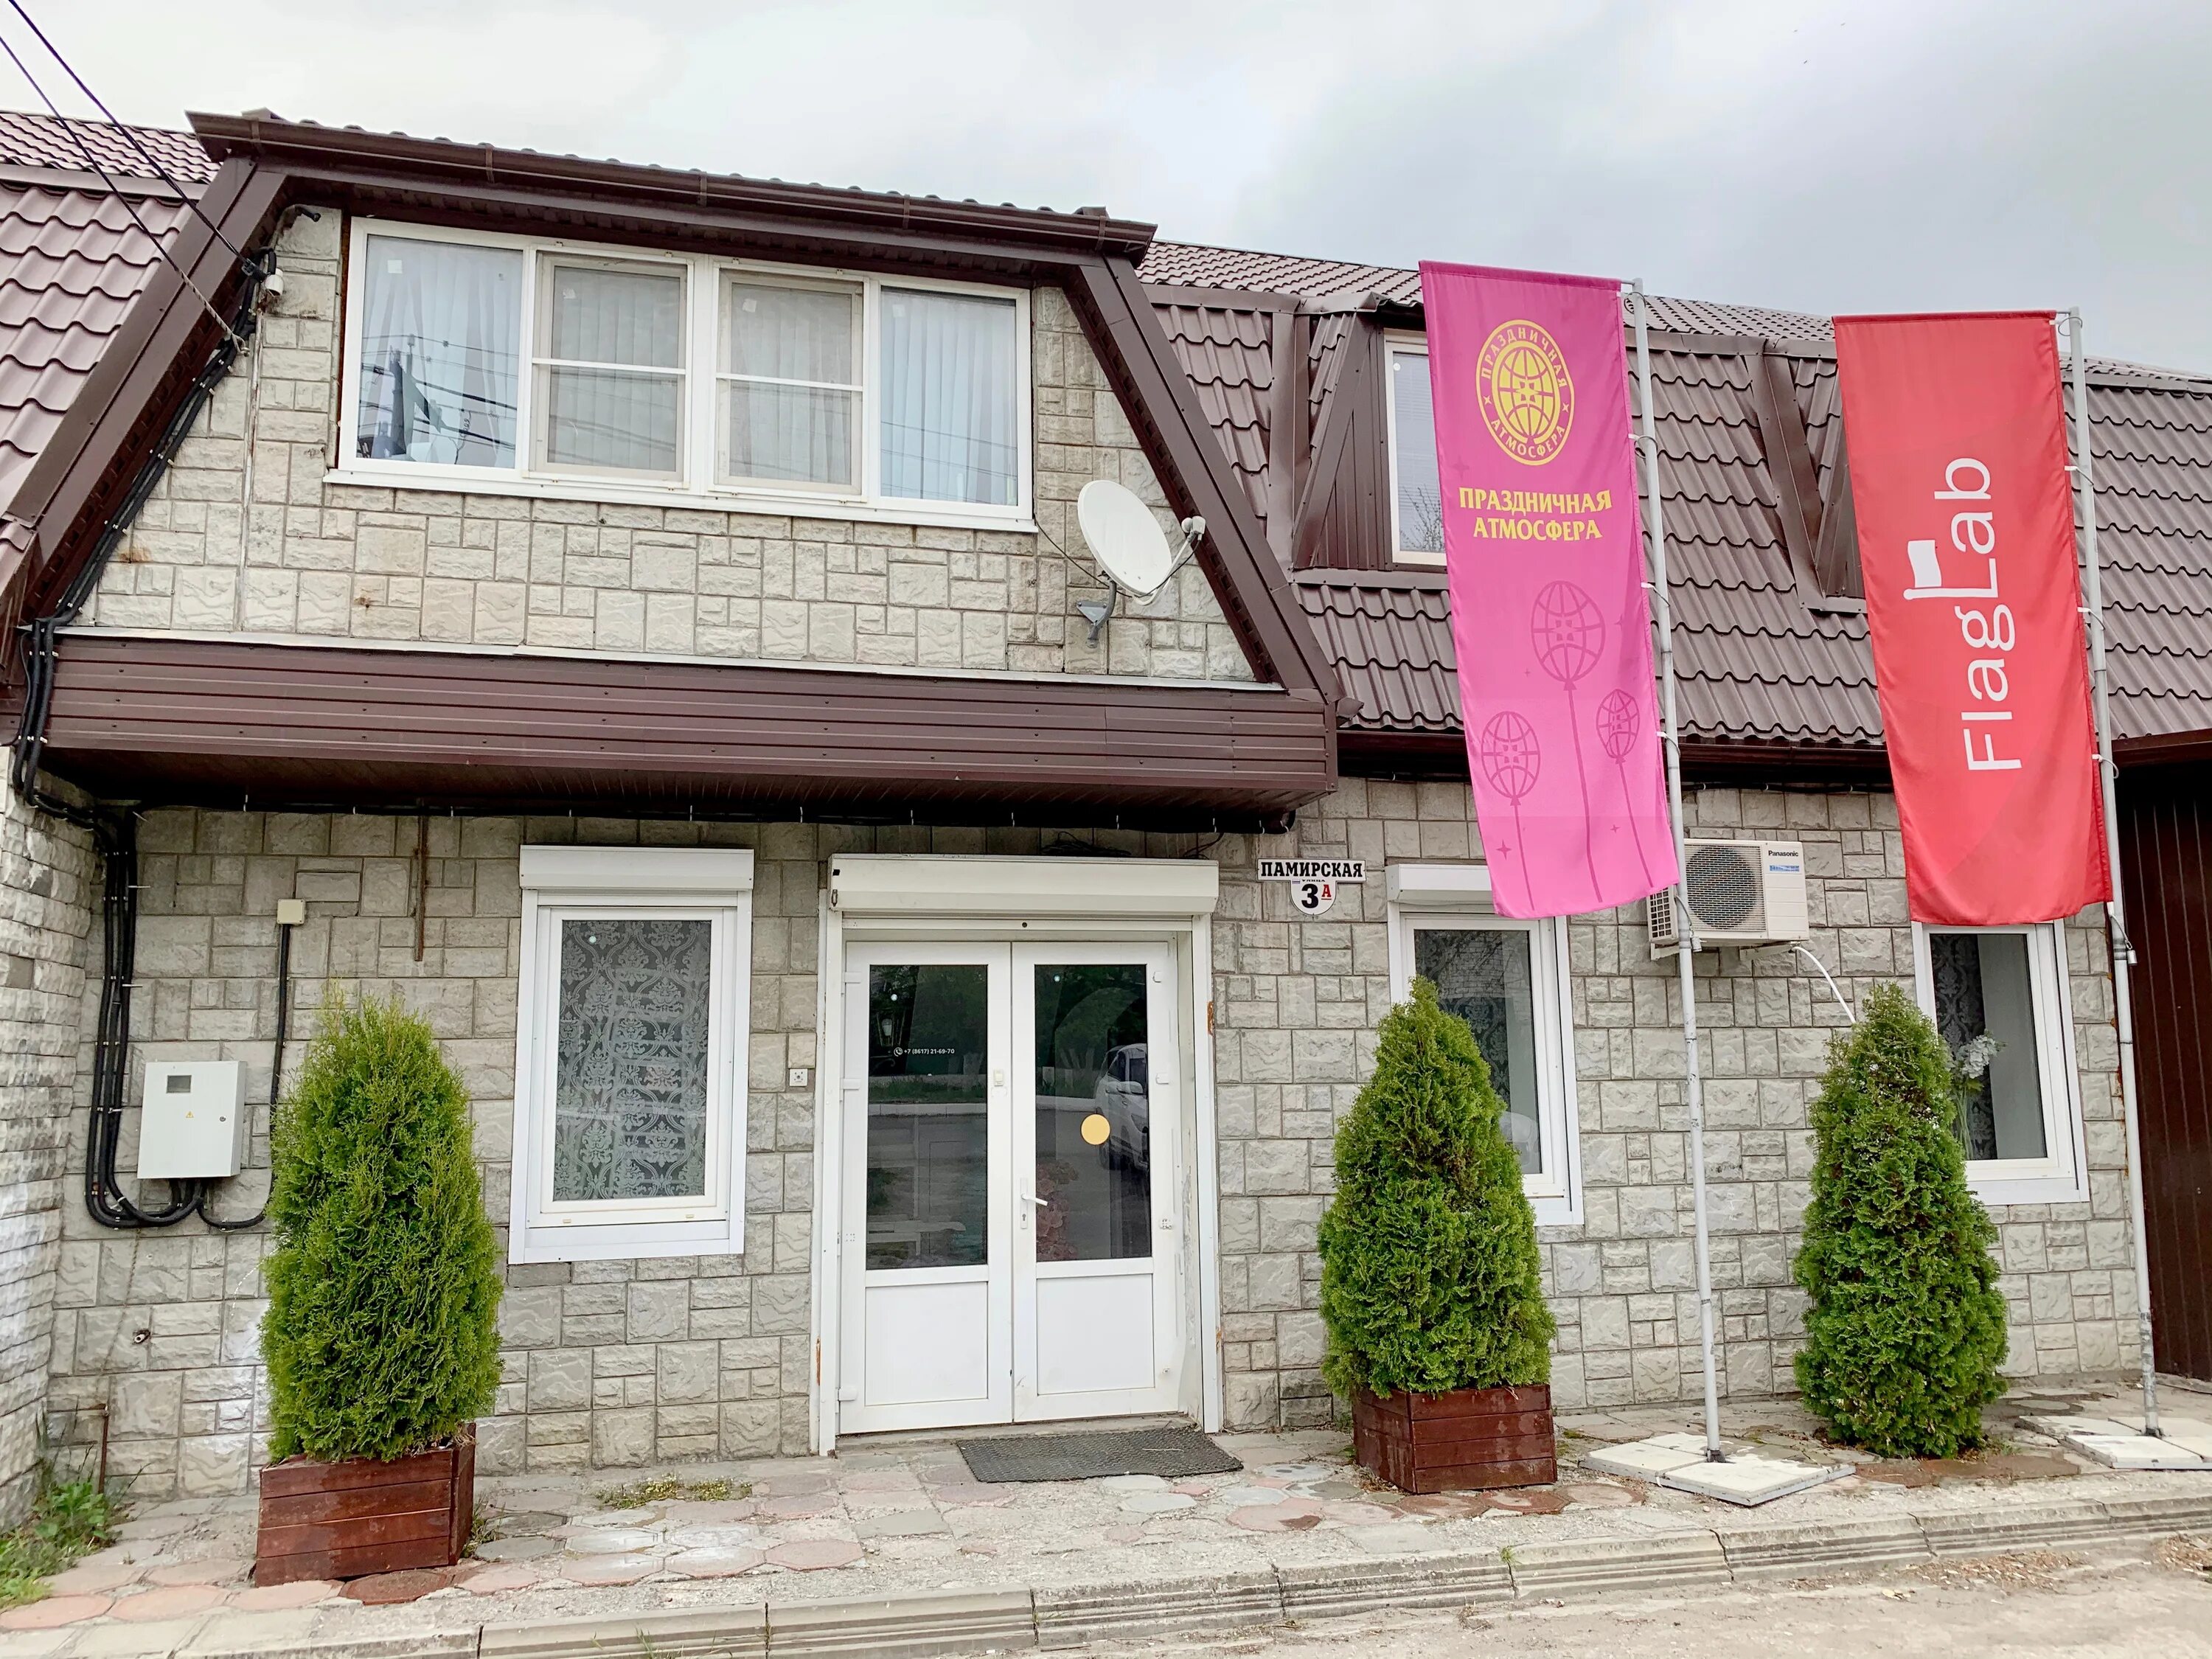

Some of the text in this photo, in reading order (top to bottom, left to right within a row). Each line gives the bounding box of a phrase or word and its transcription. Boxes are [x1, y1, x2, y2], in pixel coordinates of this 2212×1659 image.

[1481, 327, 1568, 388] ПРАЗДНИЧНАЯ
[1490, 418, 1565, 459] АТМОСФЕРА
[1458, 487, 1613, 516] ПРАЗДНИЧНАЯ
[1473, 517, 1602, 542] АТМОСФЕРА
[1903, 457, 2023, 772] FlagLab
[1261, 861, 1363, 877] ПАМИРСКАЯ
